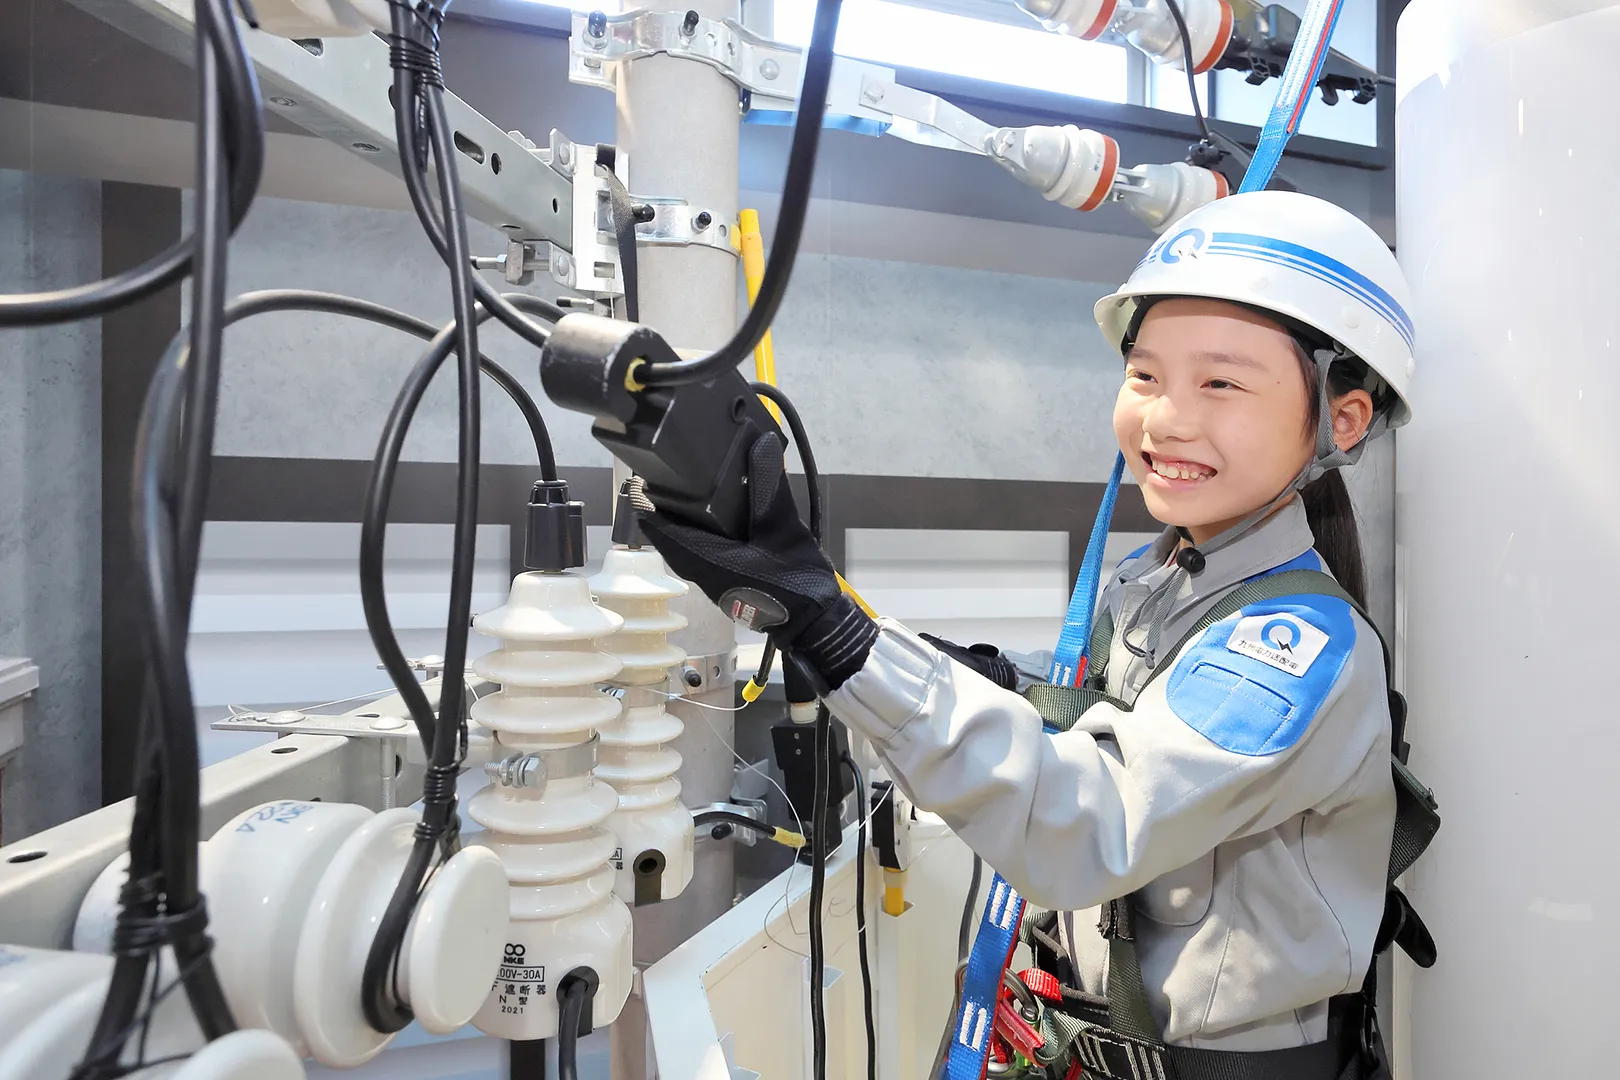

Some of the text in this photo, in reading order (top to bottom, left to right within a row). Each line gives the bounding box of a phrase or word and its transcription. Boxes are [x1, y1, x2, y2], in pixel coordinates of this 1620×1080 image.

[1238, 639, 1299, 670] 九州電力送配電
[503, 956, 524, 964] NKE
[498, 968, 540, 979] 00V-30A
[501, 1005, 523, 1014] 2021
